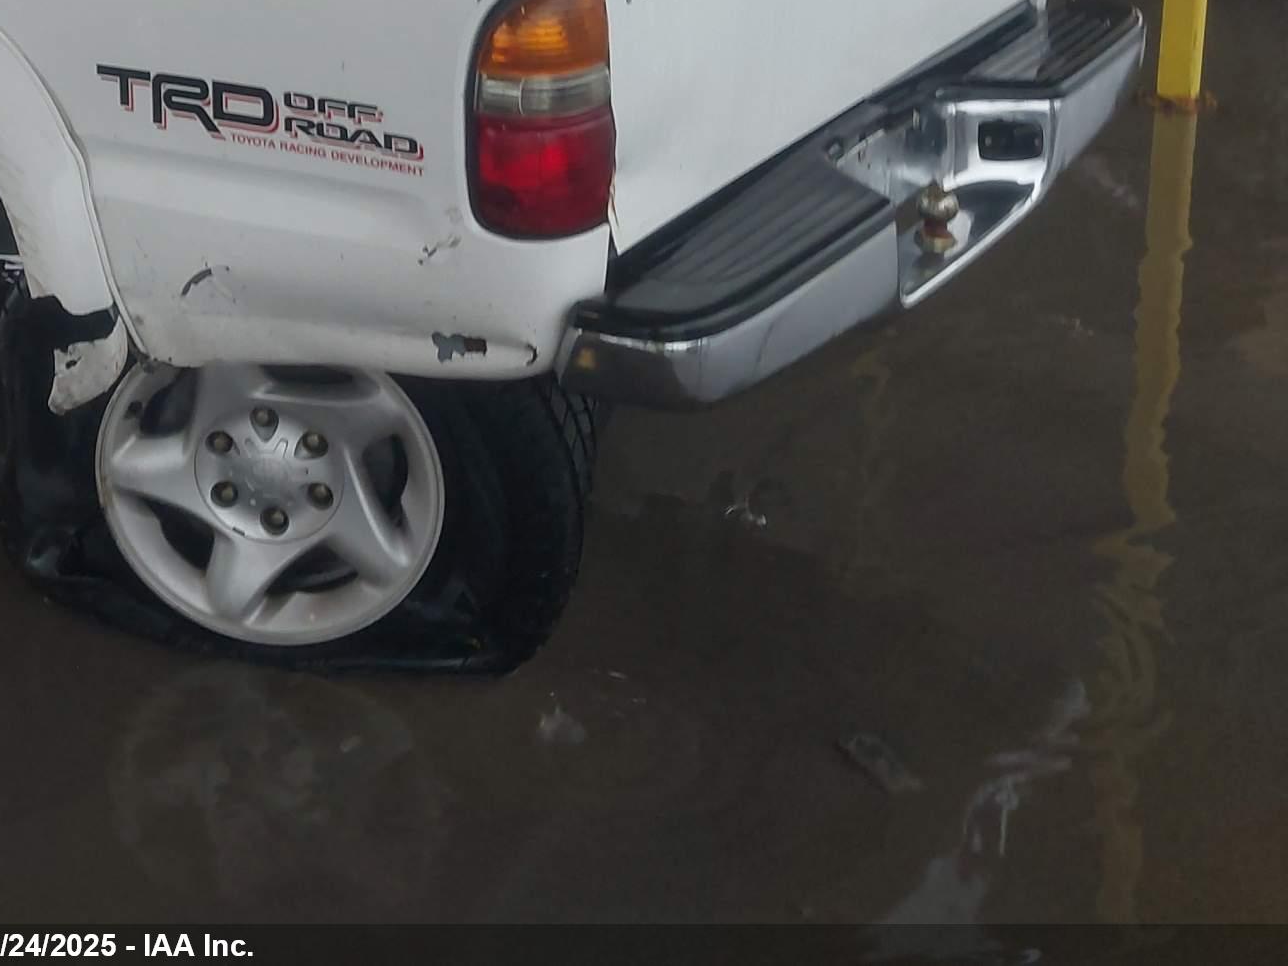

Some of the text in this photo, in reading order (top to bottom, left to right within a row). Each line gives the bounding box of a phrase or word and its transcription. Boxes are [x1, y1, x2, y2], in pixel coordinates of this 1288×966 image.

[96, 64, 280, 141] TRD
[283, 91, 383, 124] OFF
[228, 133, 424, 177] TOYOTA RACING DEVELOPMENT
[284, 116, 424, 161] ROAD
